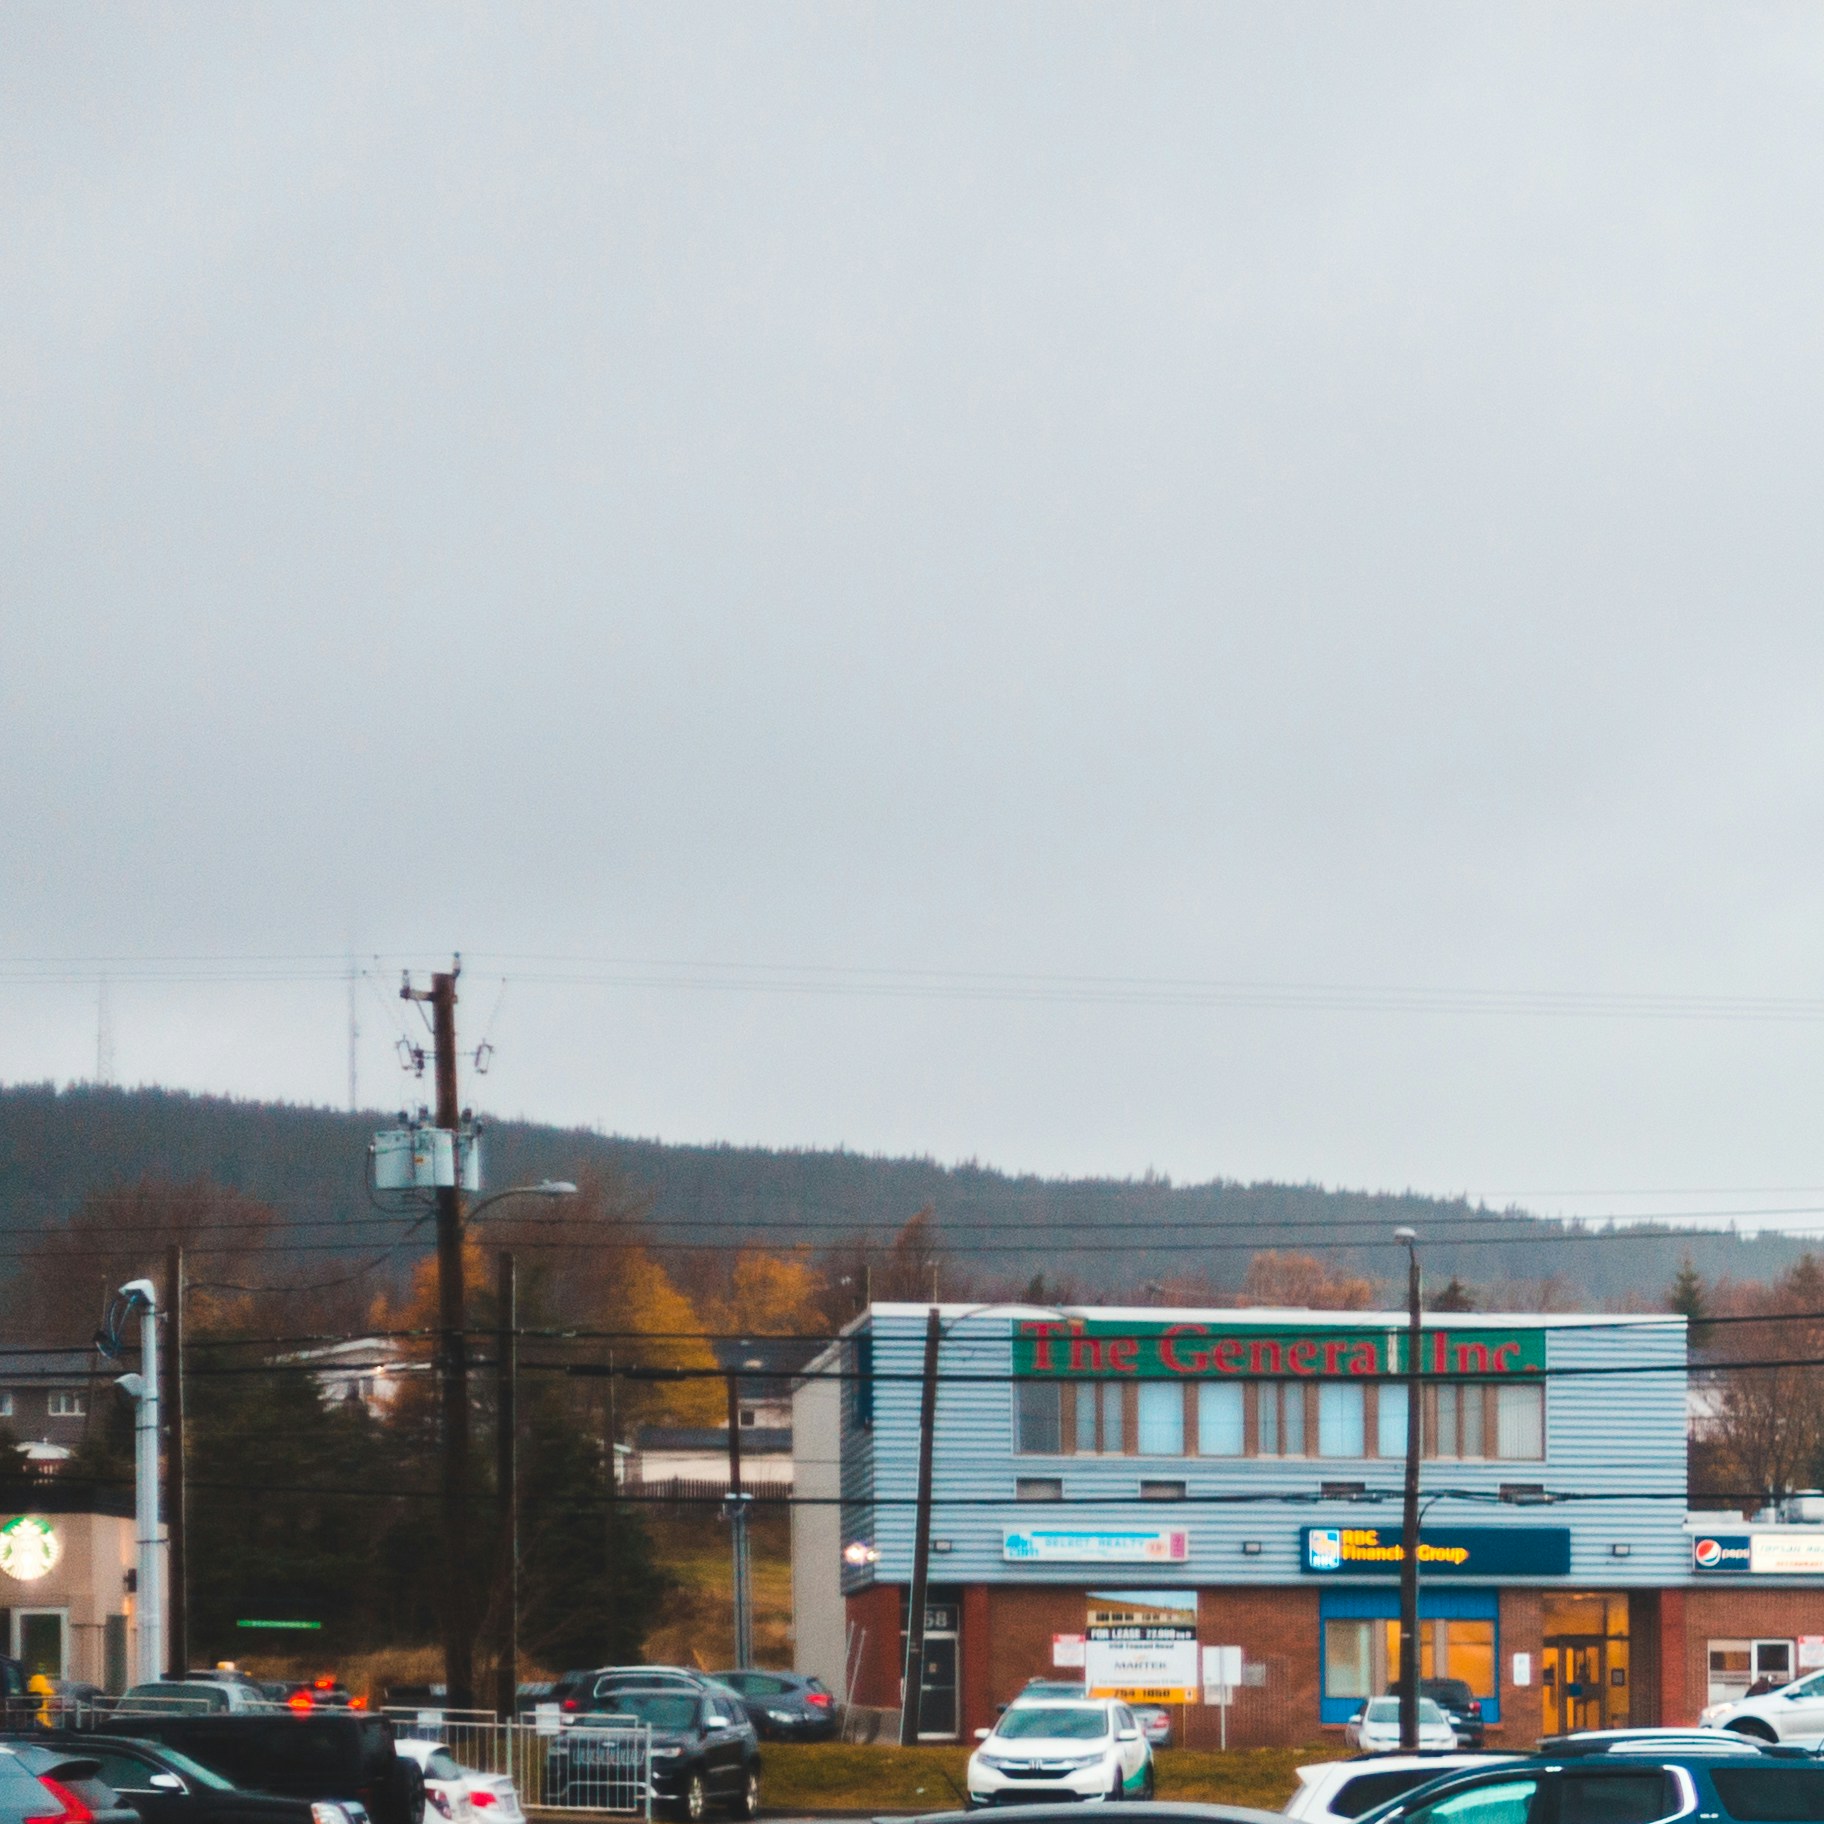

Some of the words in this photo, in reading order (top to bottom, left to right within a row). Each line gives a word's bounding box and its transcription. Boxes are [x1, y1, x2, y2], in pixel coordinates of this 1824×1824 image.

[1021, 1322, 1139, 1371] The
[1433, 1331, 1538, 1374] Inc.
[1416, 1544, 1469, 1565] Group
[1091, 1628, 1109, 1639] FOR
[1112, 1628, 1140, 1639] LEASE
